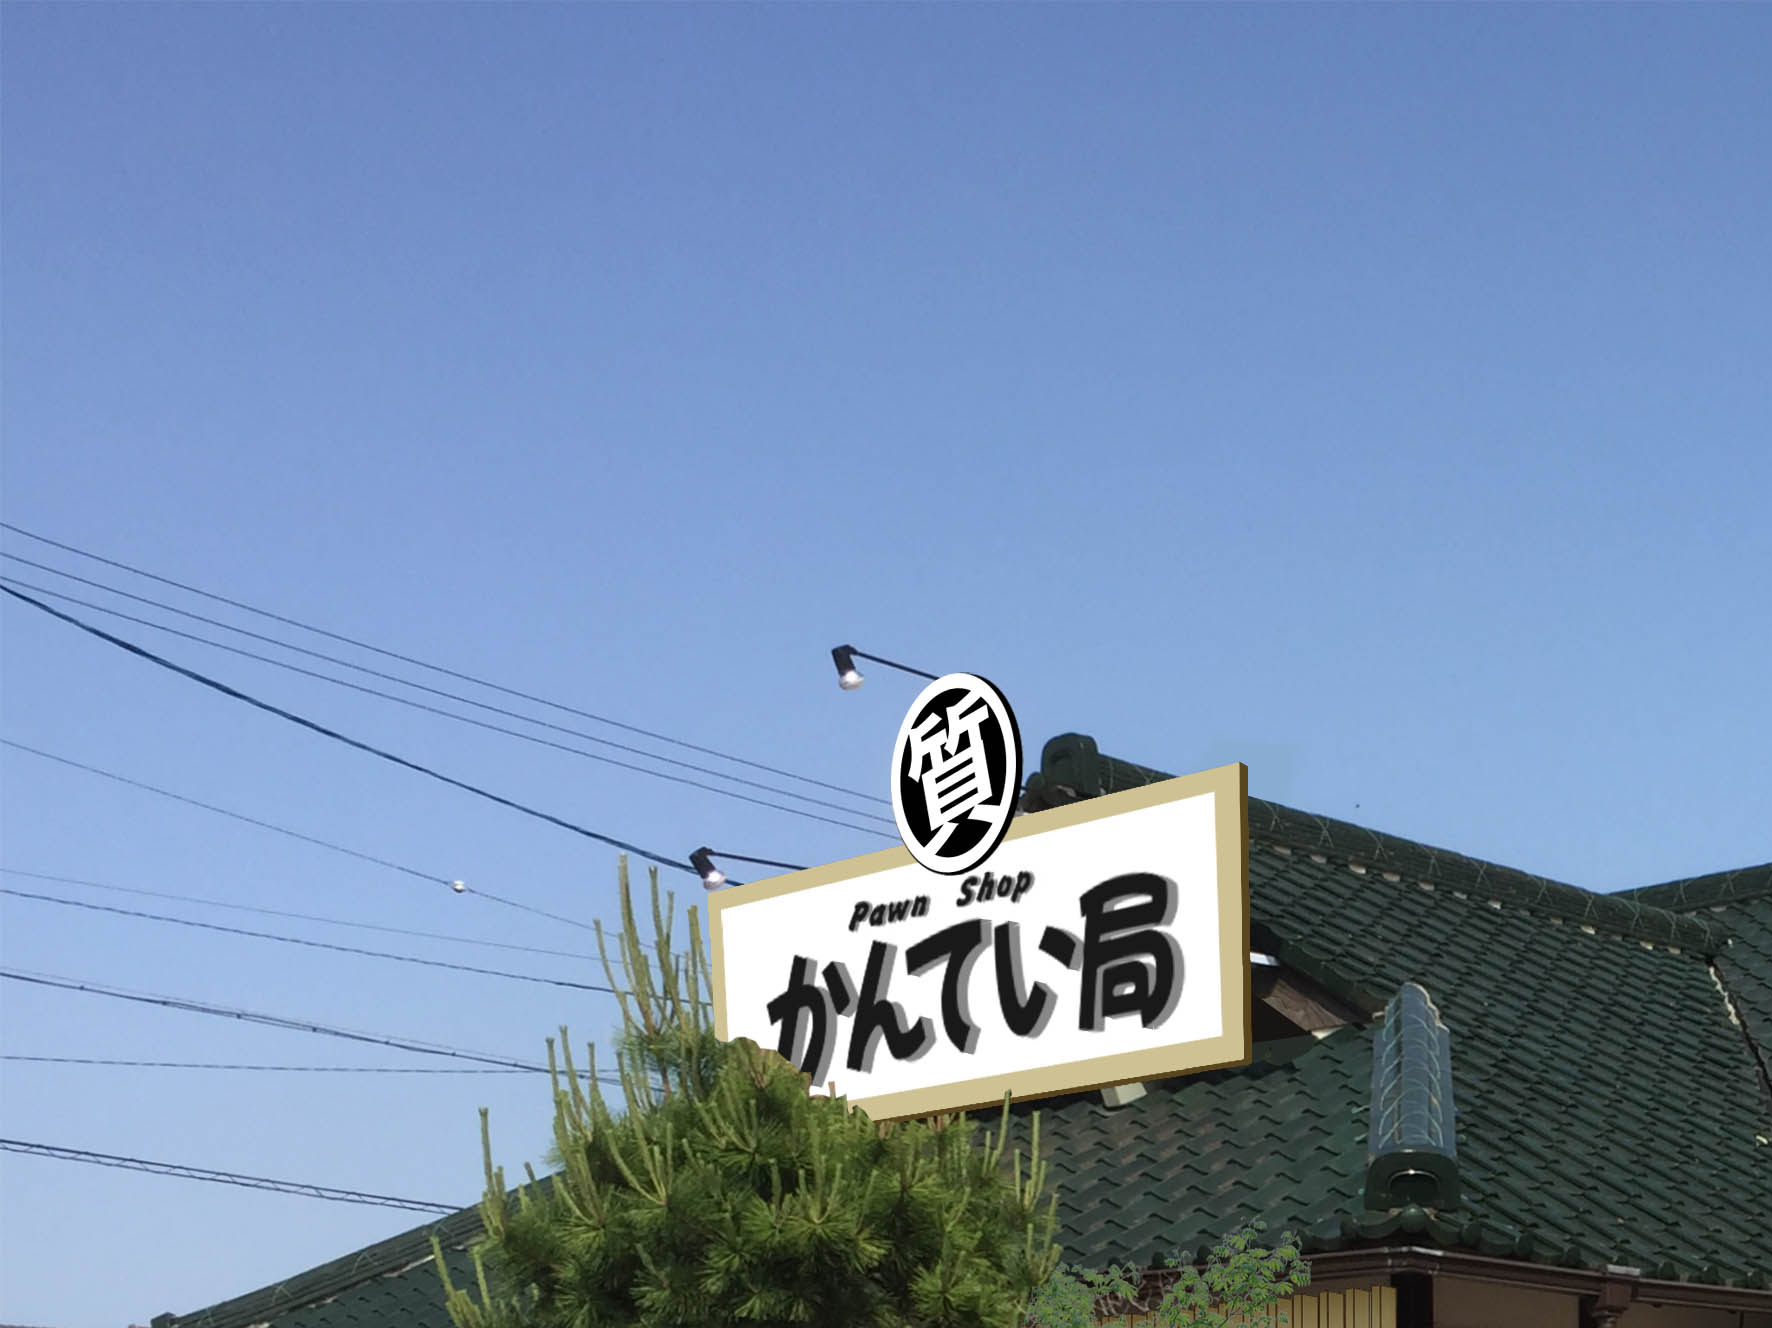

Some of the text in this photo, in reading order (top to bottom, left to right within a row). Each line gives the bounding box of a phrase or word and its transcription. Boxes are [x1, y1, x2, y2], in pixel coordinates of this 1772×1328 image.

[900, 688, 1000, 860] 質
[766, 872, 1184, 1087] かんてい局
[849, 871, 1033, 931] Pawn Shop
